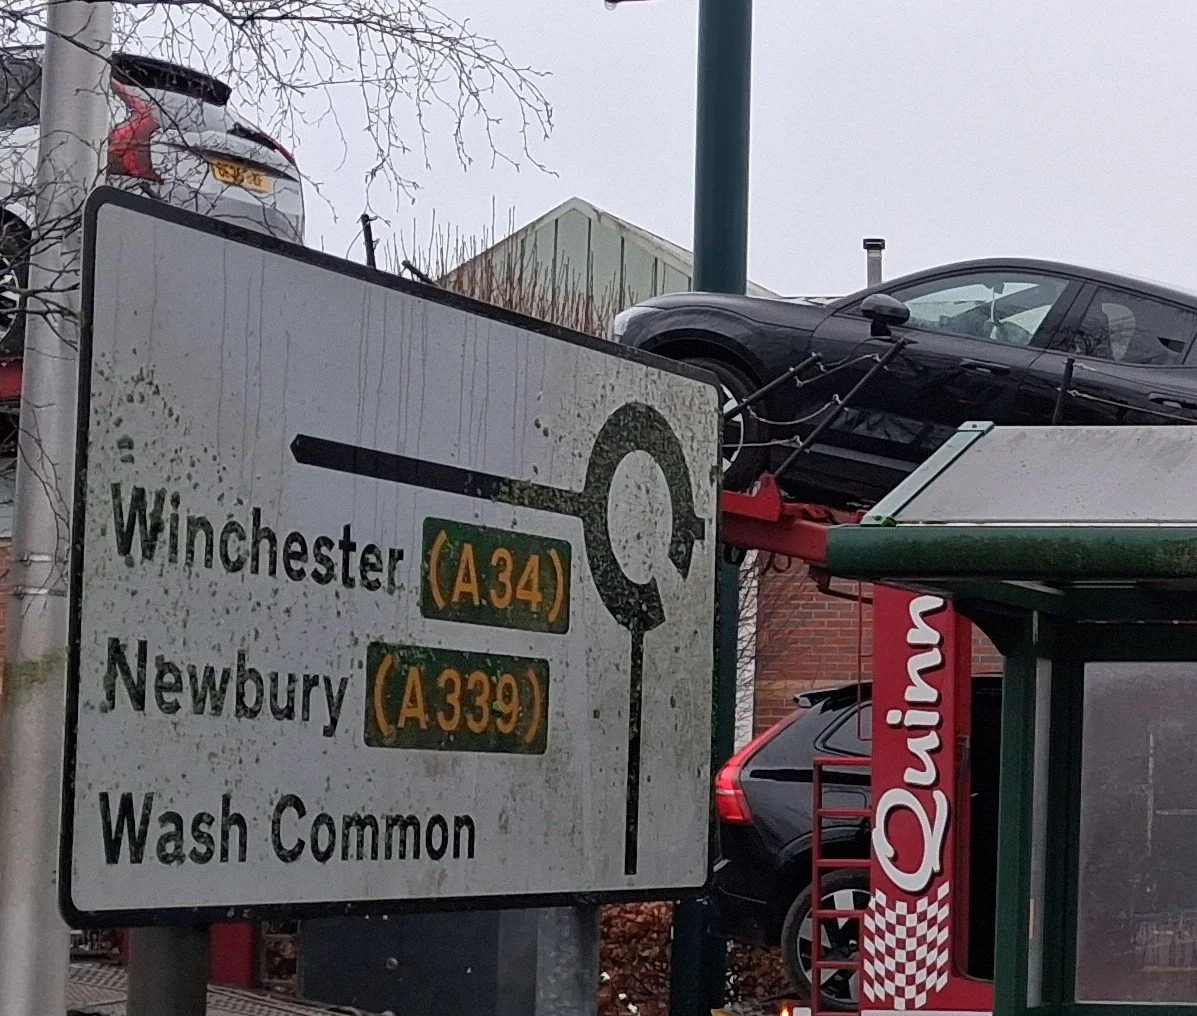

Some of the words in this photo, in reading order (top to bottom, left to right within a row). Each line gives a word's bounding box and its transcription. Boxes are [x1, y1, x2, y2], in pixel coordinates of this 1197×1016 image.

[110, 483, 404, 595] Winchester
[104, 637, 348, 737] Newbury
[873, 595, 949, 892] Quinn
[99, 792, 248, 865] Wash
[271, 794, 475, 863] Common
